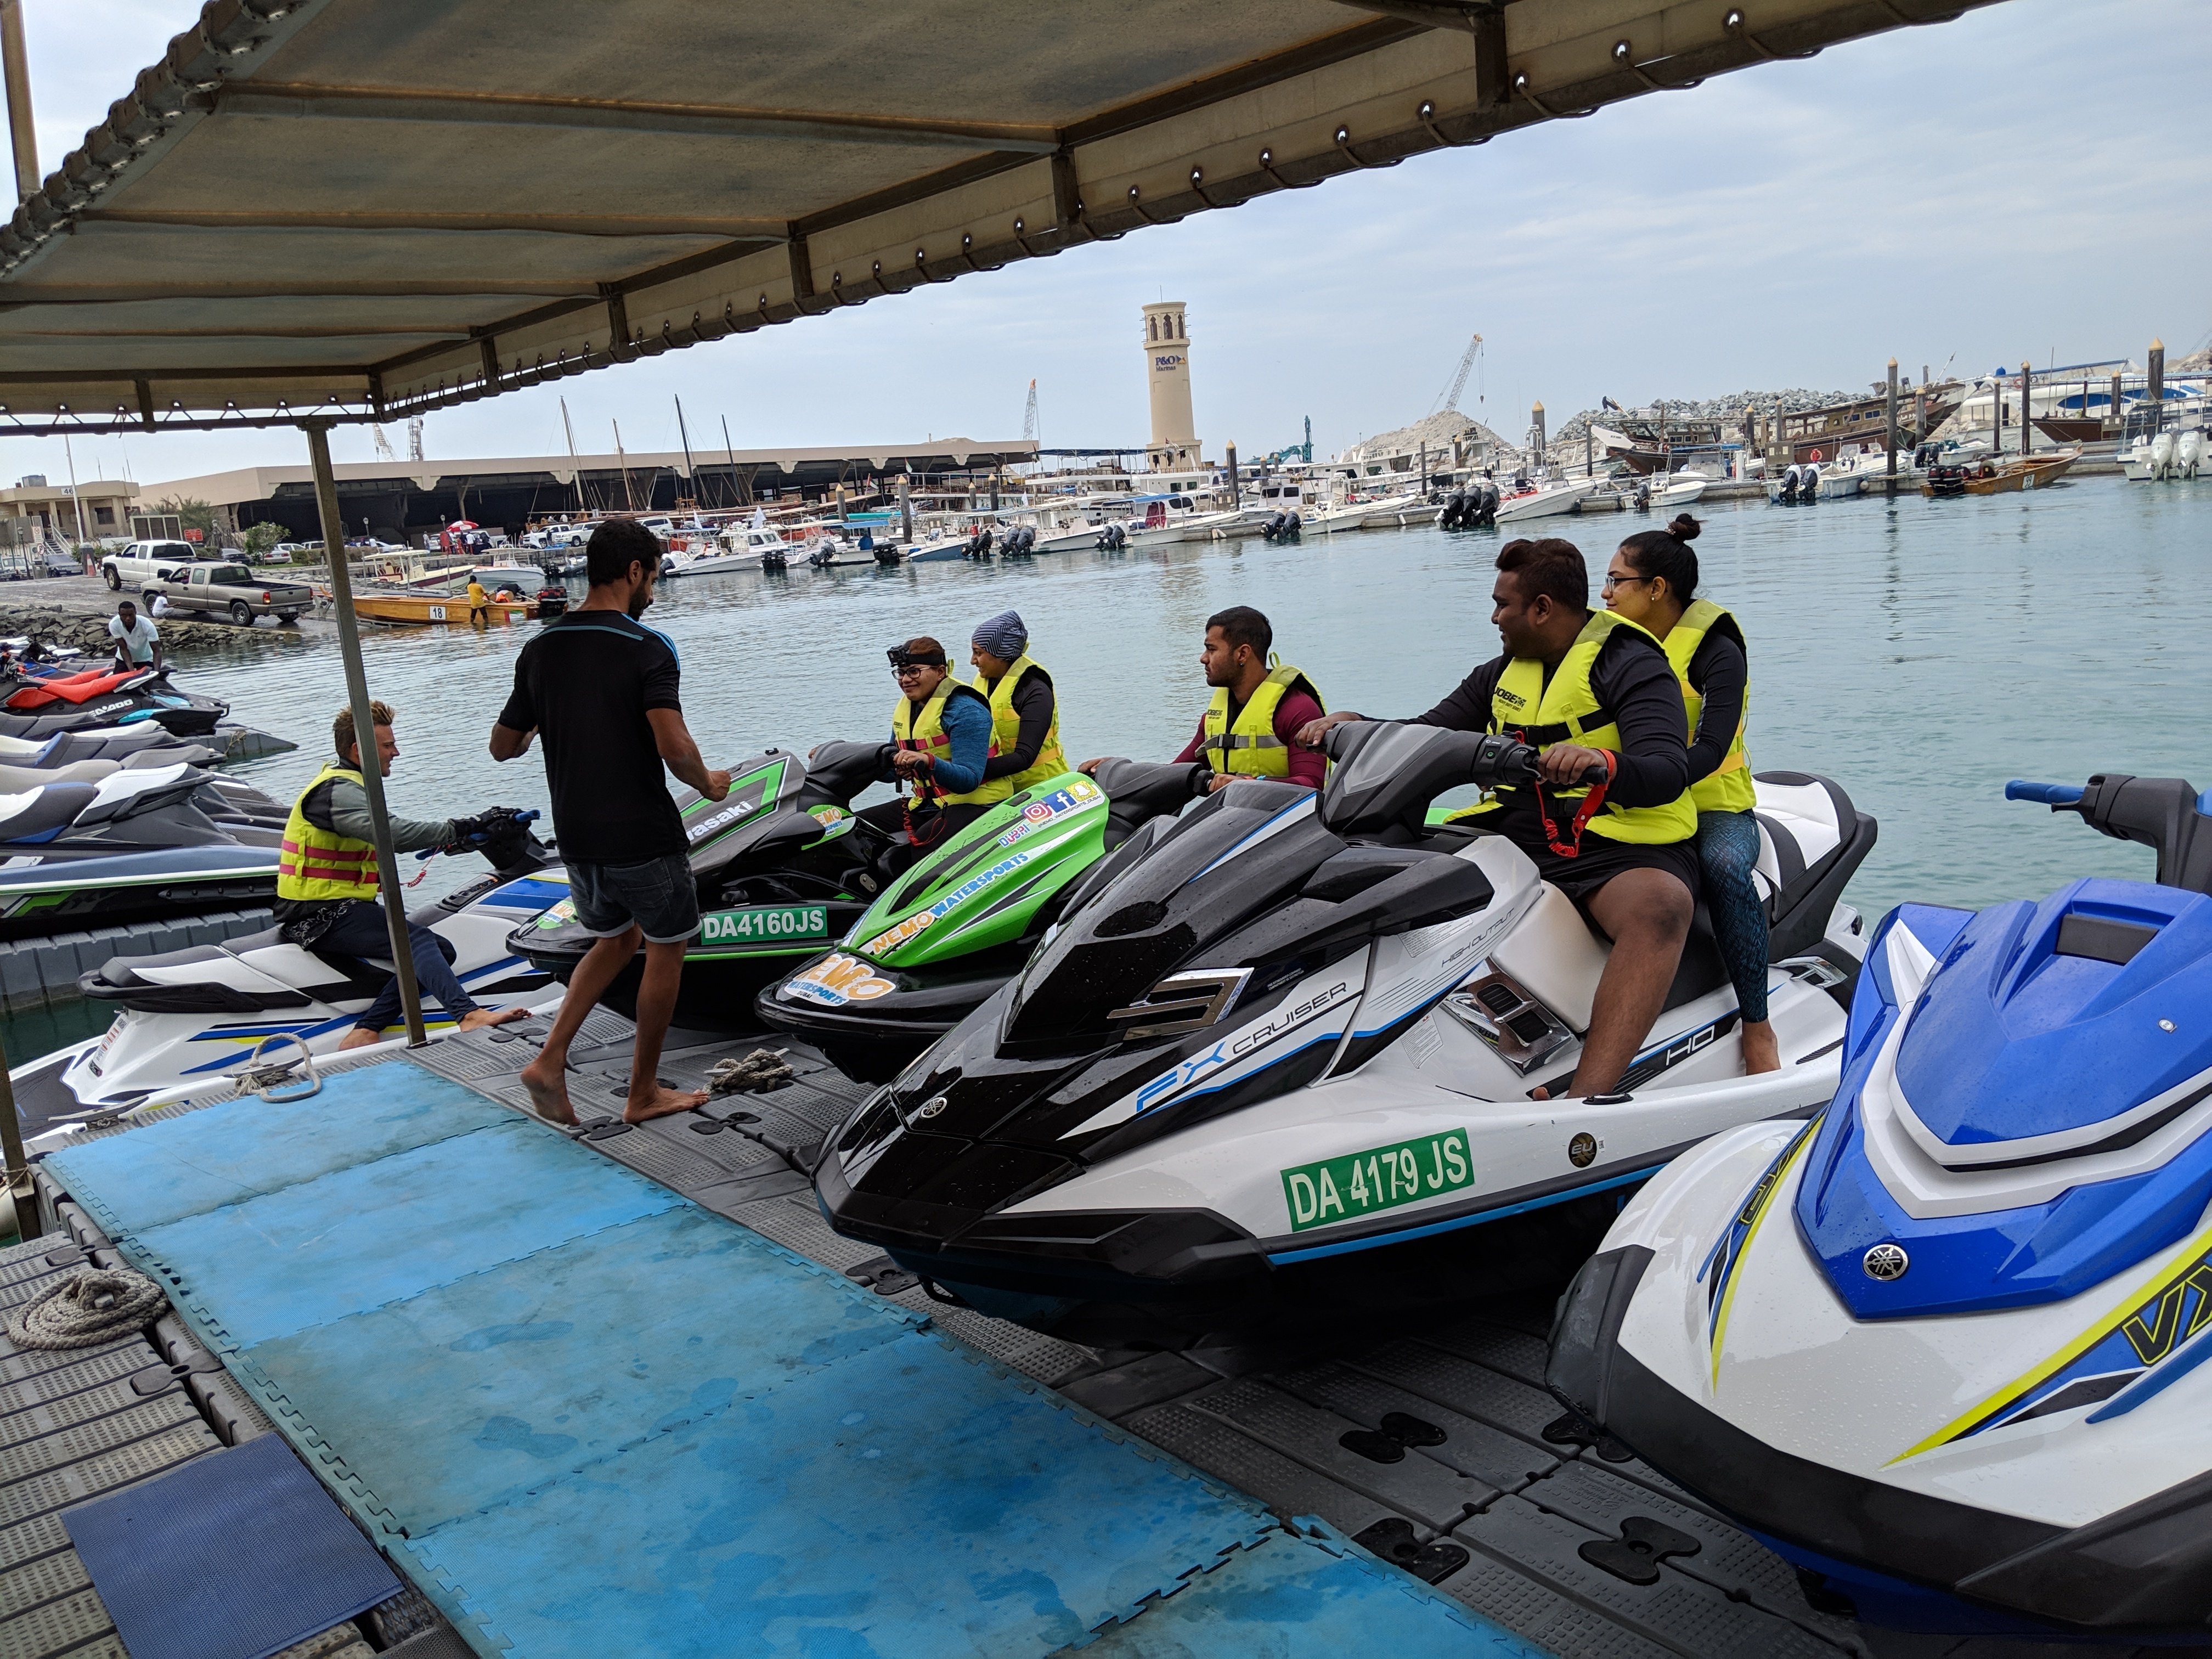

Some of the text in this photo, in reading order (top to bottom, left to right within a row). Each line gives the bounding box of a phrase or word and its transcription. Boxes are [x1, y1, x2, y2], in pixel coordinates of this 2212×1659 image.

[1155, 356, 1176, 365] P&O
[433, 607, 442, 618] 18
[686, 801, 753, 841] asaki
[872, 913, 932, 953] NEMO
[930, 852, 1029, 917] WATERSPORTS
[703, 910, 823, 939] DA4160JS
[1442, 941, 1471, 968] HIGH
[1472, 907, 1514, 946] OUTPUT
[788, 981, 847, 1005] WATERSPORTS
[796, 990, 813, 998] DUBAI
[1137, 1041, 1226, 1113] FX
[1233, 982, 1346, 1054] CRUISER
[1666, 1024, 1715, 1066] HO
[1571, 1141, 1594, 1154] EU
[1289, 1137, 1466, 1224] DA 4179 JS
